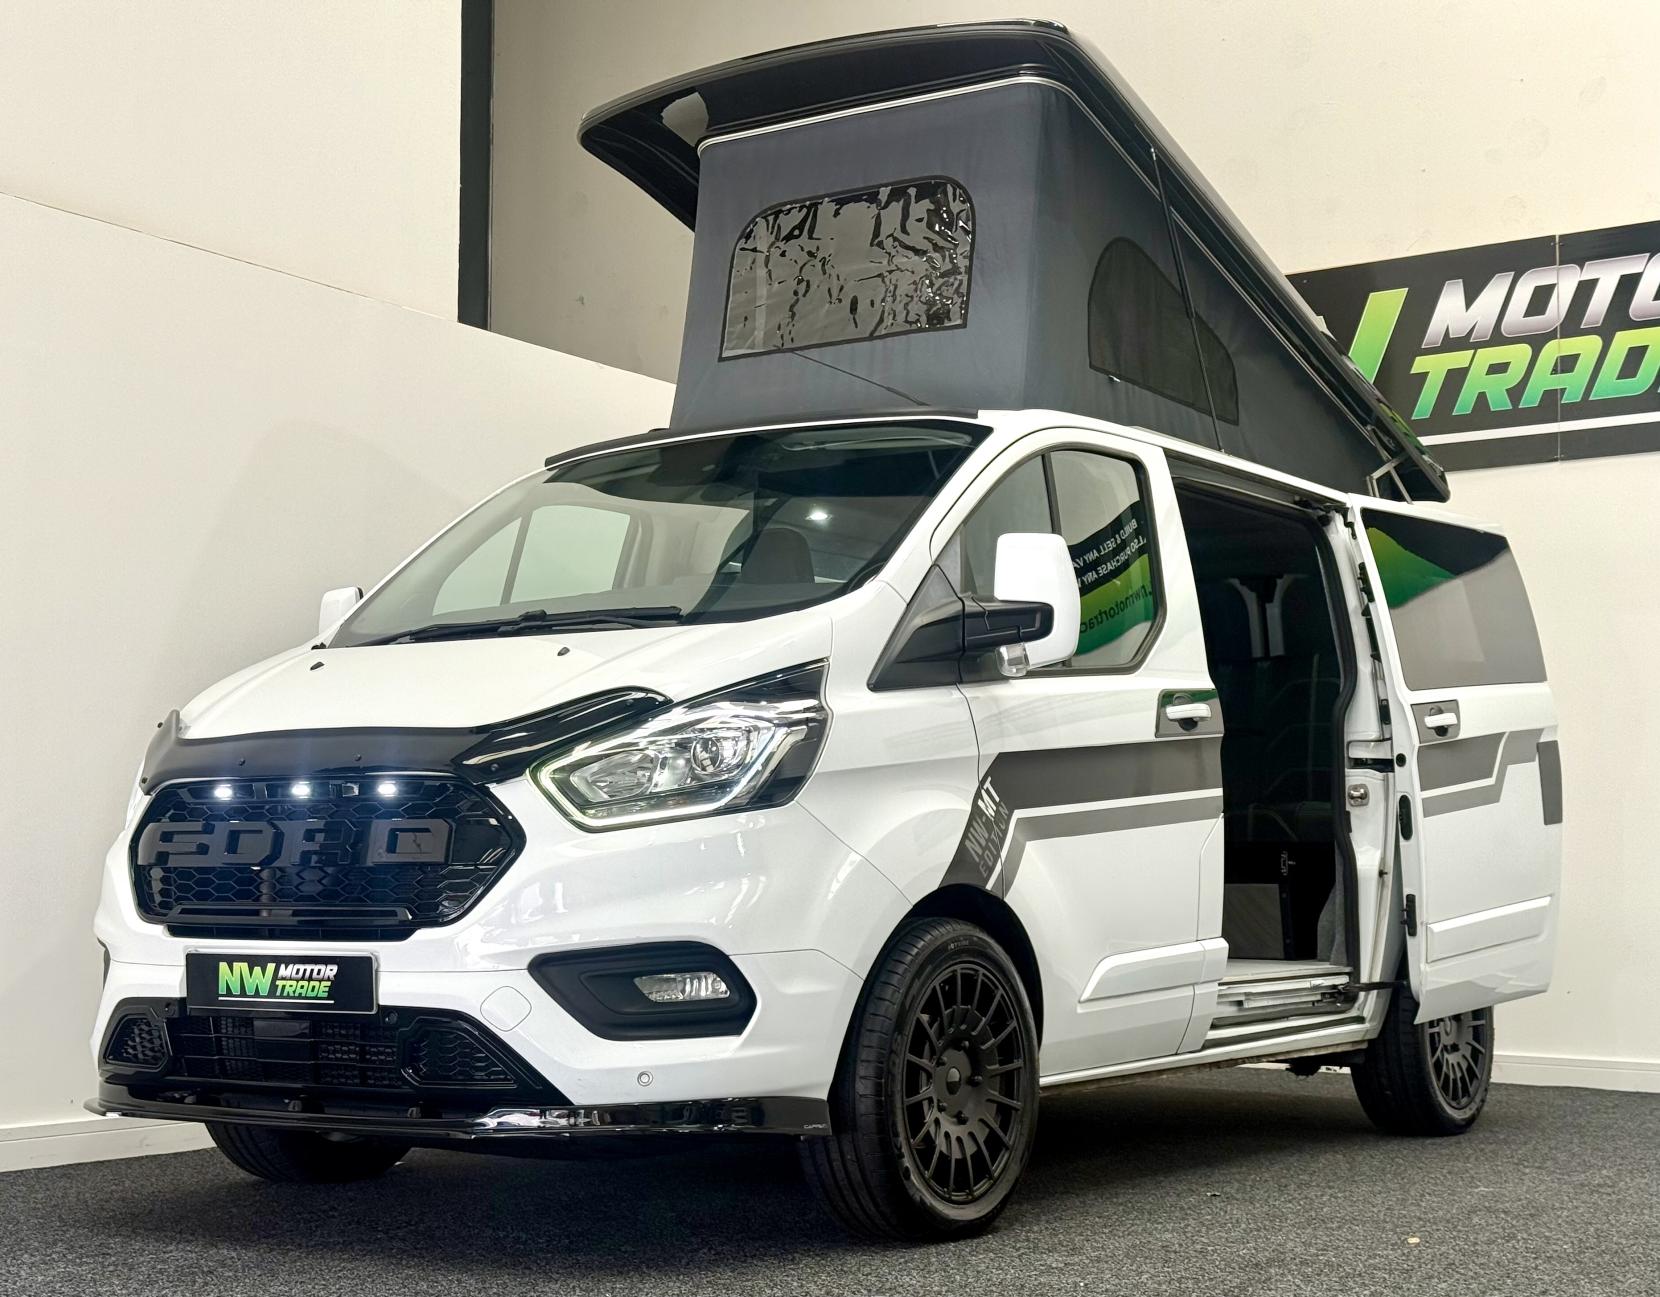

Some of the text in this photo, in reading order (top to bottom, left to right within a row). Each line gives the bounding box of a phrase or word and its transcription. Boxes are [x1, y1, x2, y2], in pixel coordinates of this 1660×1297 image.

[1410, 326, 1660, 420] TRAD
[137, 819, 453, 867] FORD
[979, 801, 1009, 878] EDITION
[218, 961, 276, 996] NW
[275, 980, 331, 997] TRADE
[277, 963, 338, 981] MOTOR
